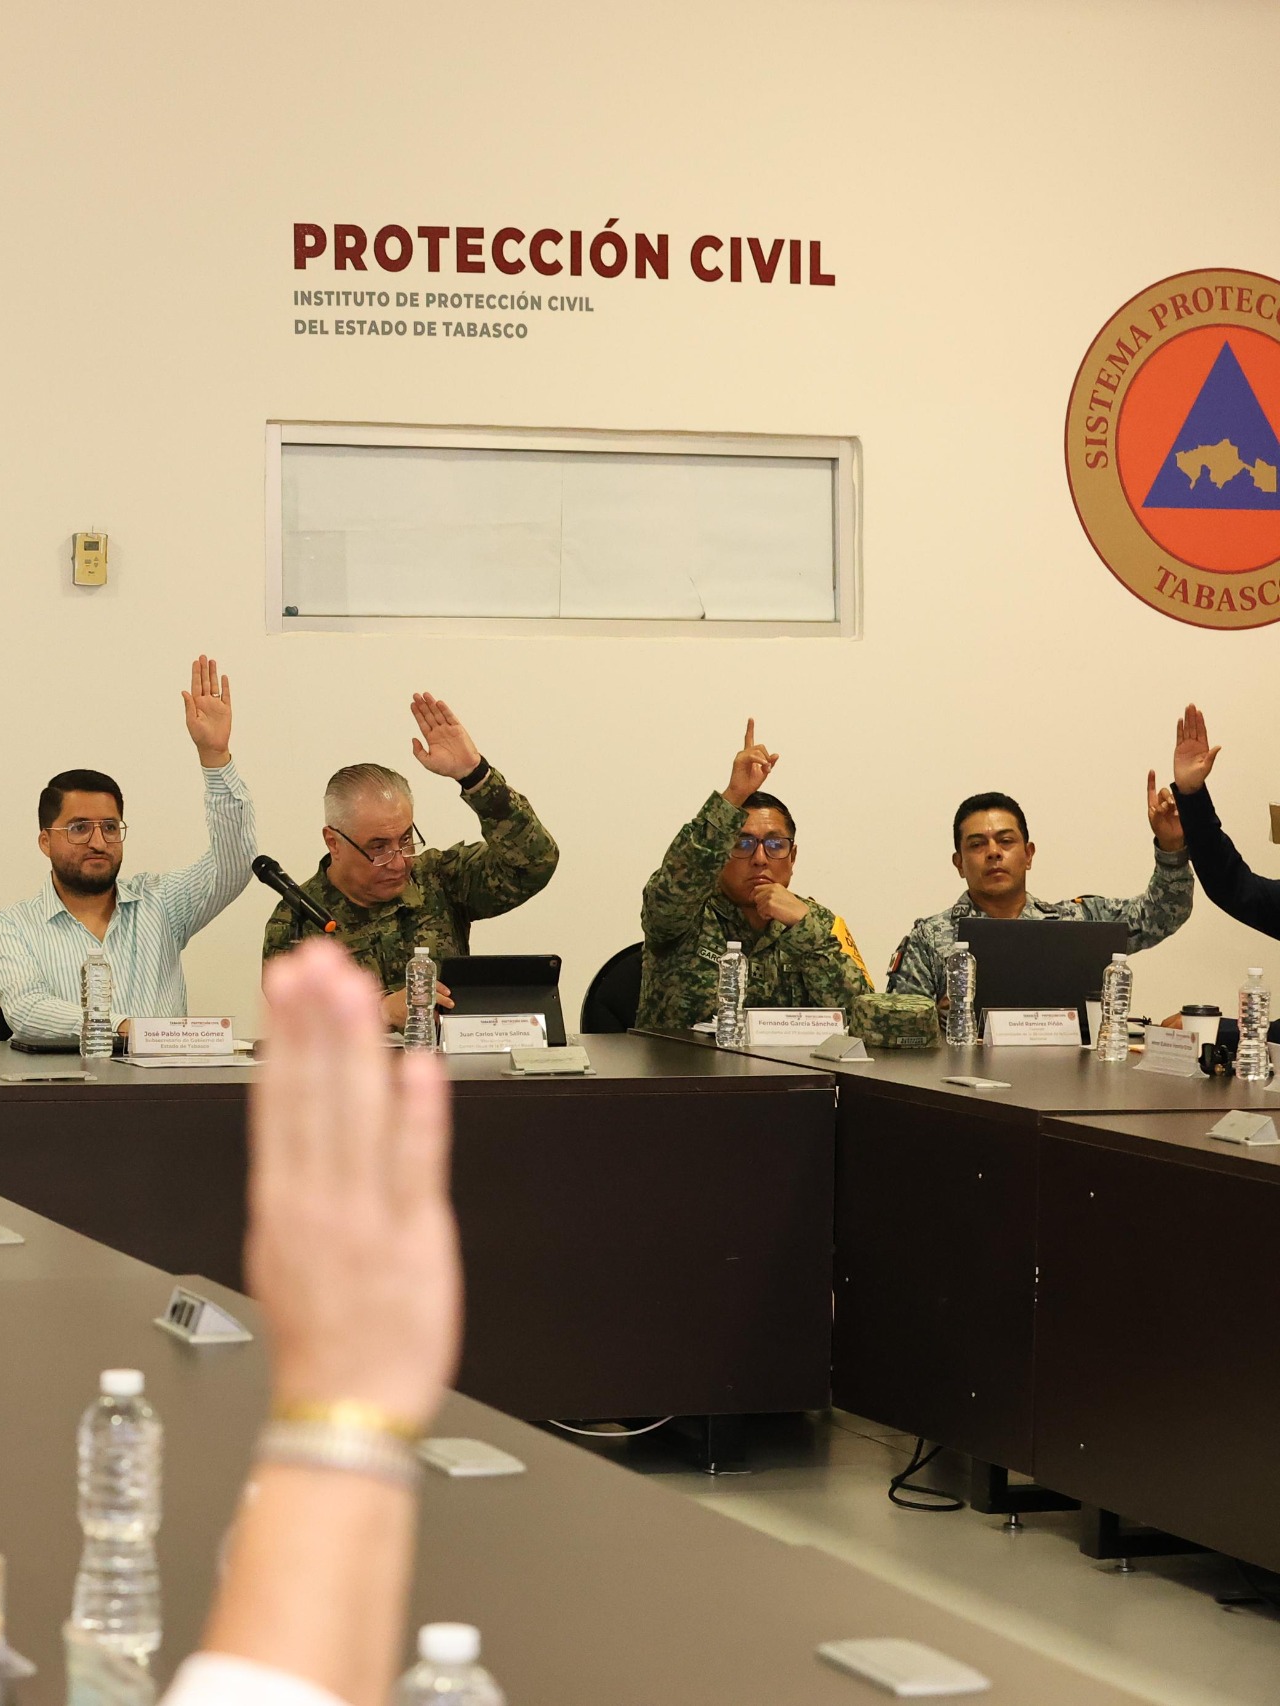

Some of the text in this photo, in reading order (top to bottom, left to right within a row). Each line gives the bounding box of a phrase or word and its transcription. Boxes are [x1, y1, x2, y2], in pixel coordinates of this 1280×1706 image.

[293, 217, 836, 287] PROTECCIÓN CIVIL
[293, 290, 595, 313] INSTITUTO DE PROTECCIÓN CIVIL
[294, 319, 528, 340] DEL ESTADO DE TABASCO
[1085, 286, 1280, 469] SISTEMA PROTEC
[1153, 566, 1280, 612] TABASC
